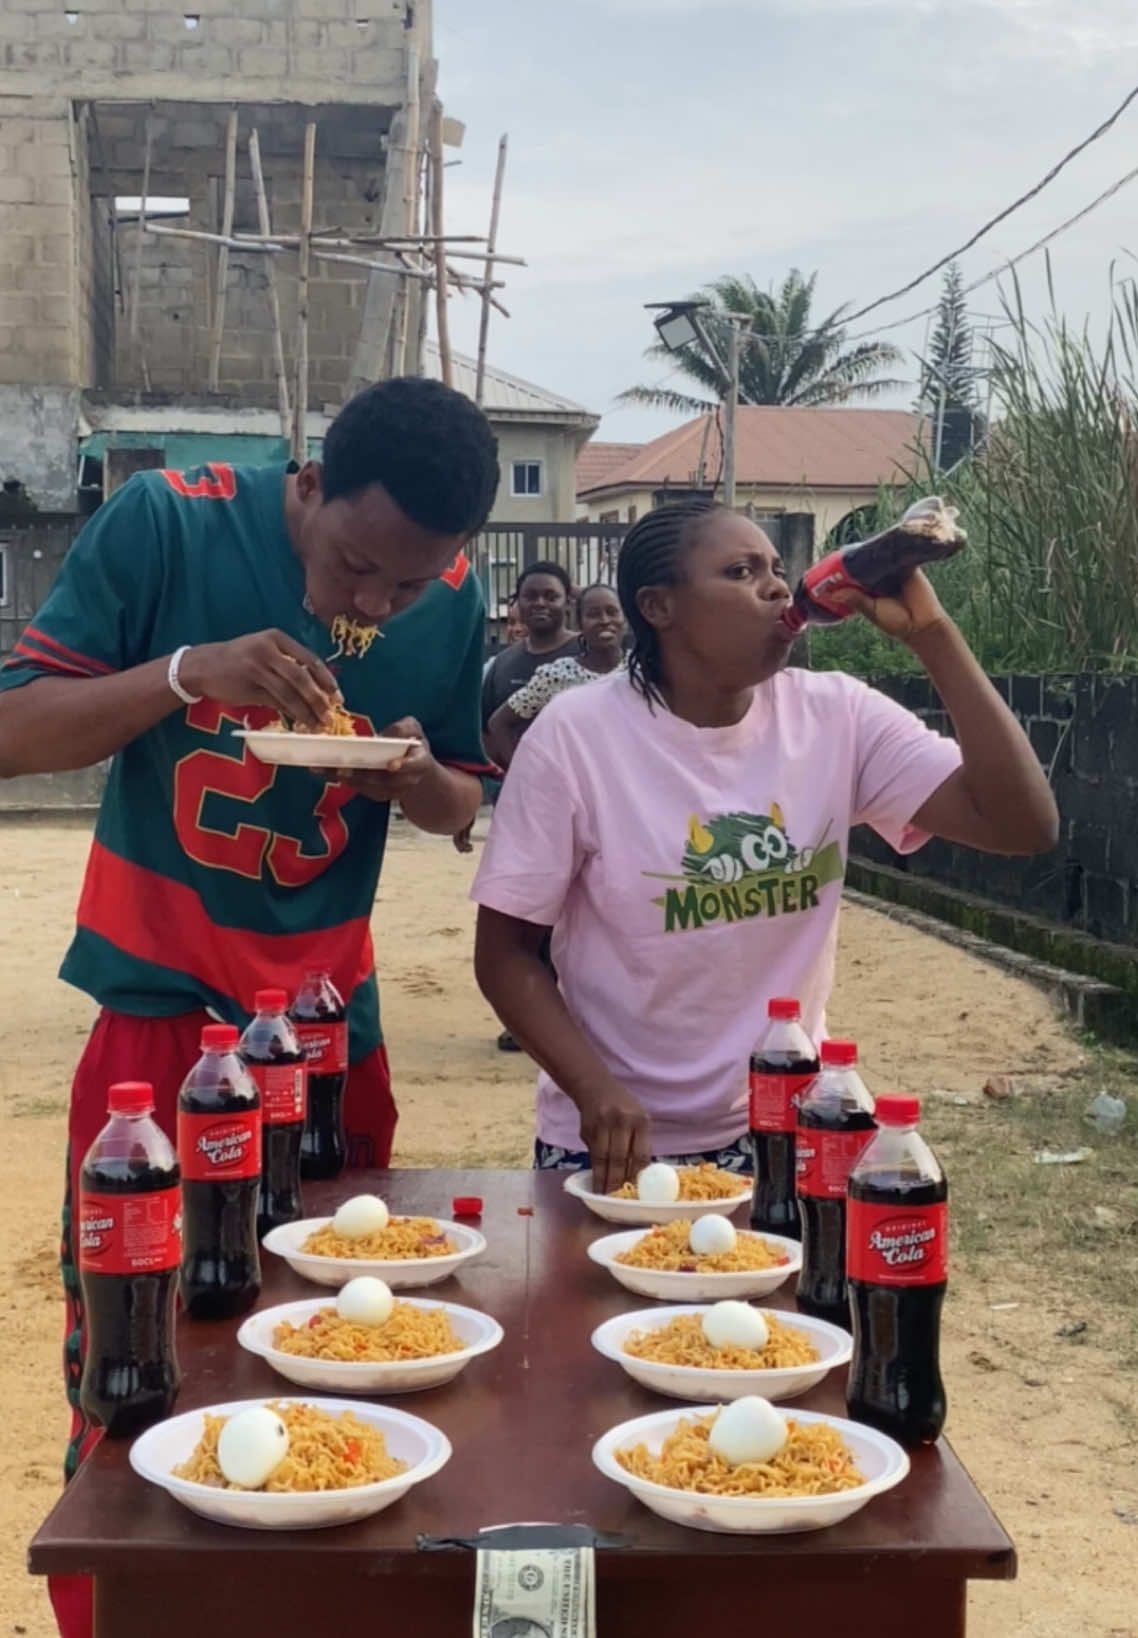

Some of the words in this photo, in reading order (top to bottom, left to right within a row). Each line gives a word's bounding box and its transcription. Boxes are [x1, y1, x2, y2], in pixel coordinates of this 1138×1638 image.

[664, 874, 820, 932] MONSTER
[195, 1130, 252, 1153] American
[207, 1146, 243, 1164] Cola
[868, 1227, 935, 1250] American
[882, 1245, 924, 1265] Cola
